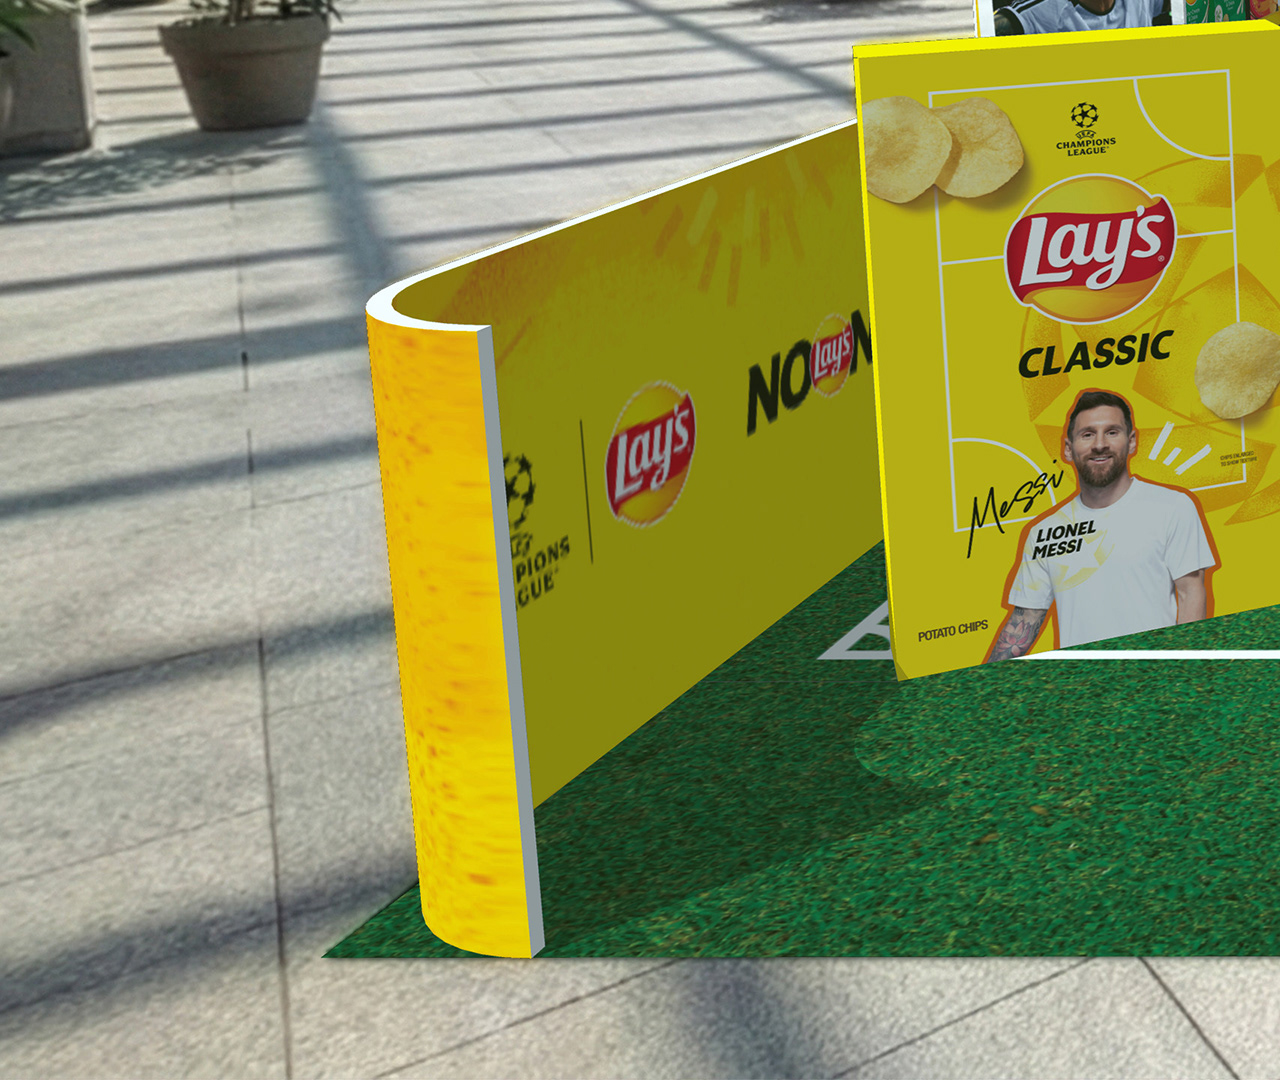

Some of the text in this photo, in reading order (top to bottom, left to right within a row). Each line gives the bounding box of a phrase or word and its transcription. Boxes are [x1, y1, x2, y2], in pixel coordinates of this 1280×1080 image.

[1056, 137, 1116, 149] CHAMPIONS
[1067, 146, 1107, 156] LEAGUE
[1018, 205, 1166, 290] Lay's
[1018, 329, 1174, 378] CLASSIC
[747, 330, 851, 437] NO Lay's
[615, 404, 690, 501] Lay's
[967, 459, 1065, 559] Messi
[1036, 520, 1097, 543] LIONEL
[515, 534, 570, 585] PIONS
[1032, 538, 1082, 560] MESSI
[918, 619, 989, 642] POTATO CHIPS
